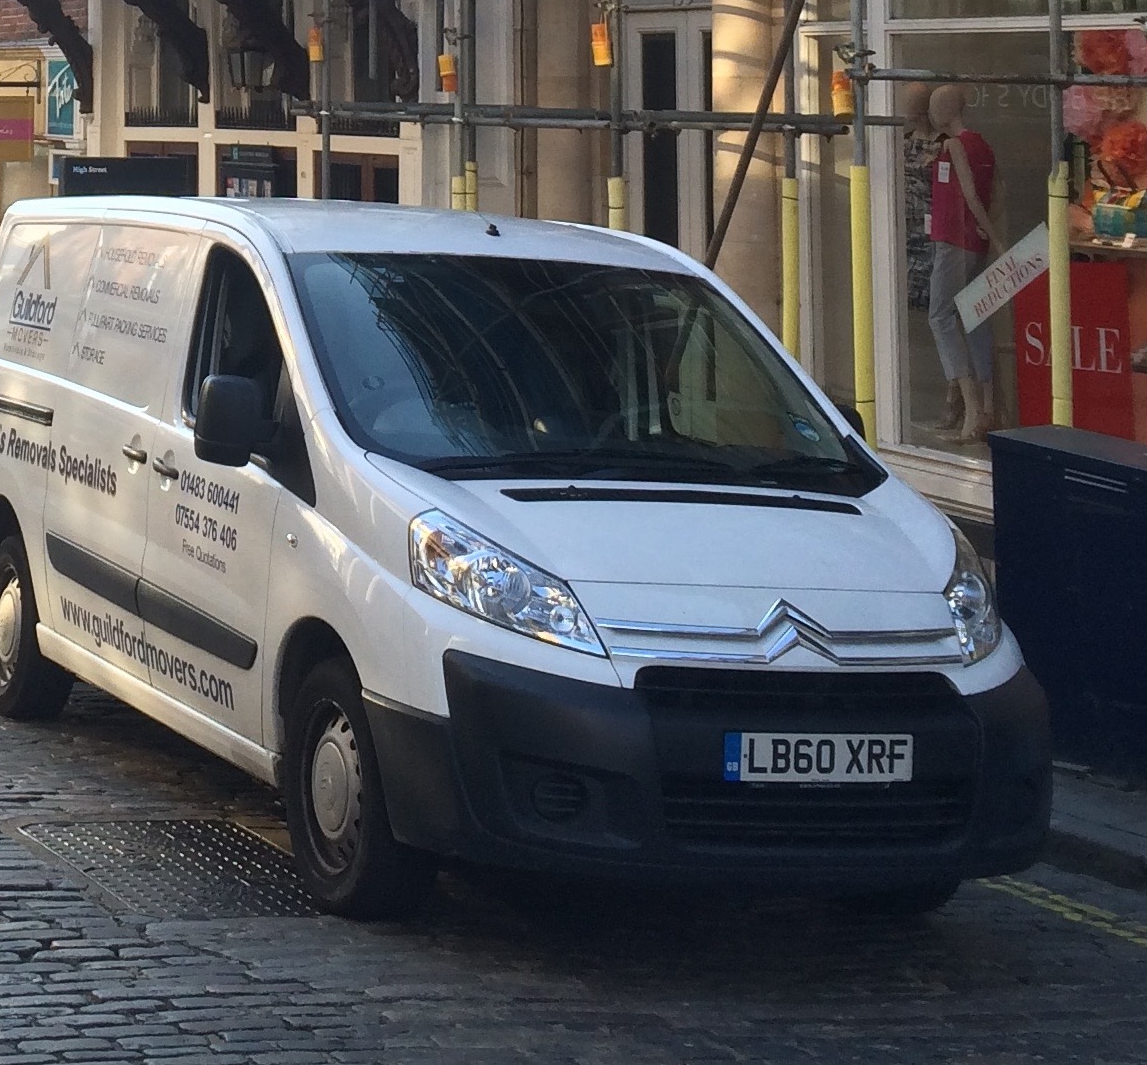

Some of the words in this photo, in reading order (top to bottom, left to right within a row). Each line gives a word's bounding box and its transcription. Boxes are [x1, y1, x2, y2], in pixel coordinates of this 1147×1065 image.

[72, 164, 87, 175] High
[88, 164, 108, 175] Street
[972, 252, 1045, 319] REDUCTIONS
[984, 255, 1018, 290] FINAL
[13, 289, 58, 326] Guildford
[10, 326, 45, 347] MOVERS
[1024, 320, 1123, 375] SLE
[7, 427, 58, 474] Removals
[59, 443, 118, 499] Specialists
[180, 469, 206, 501] 01483
[207, 481, 241, 515] 600441
[175, 503, 200, 535] 07554
[201, 515, 219, 543] 376
[219, 523, 238, 552] 406
[181, 538, 195, 559] Free
[195, 545, 227, 575] Quotations
[60, 596, 236, 712] www.guildfordmovers.com
[726, 761, 740, 773] GB
[747, 738, 836, 775] LB60
[844, 738, 909, 775] XRF
